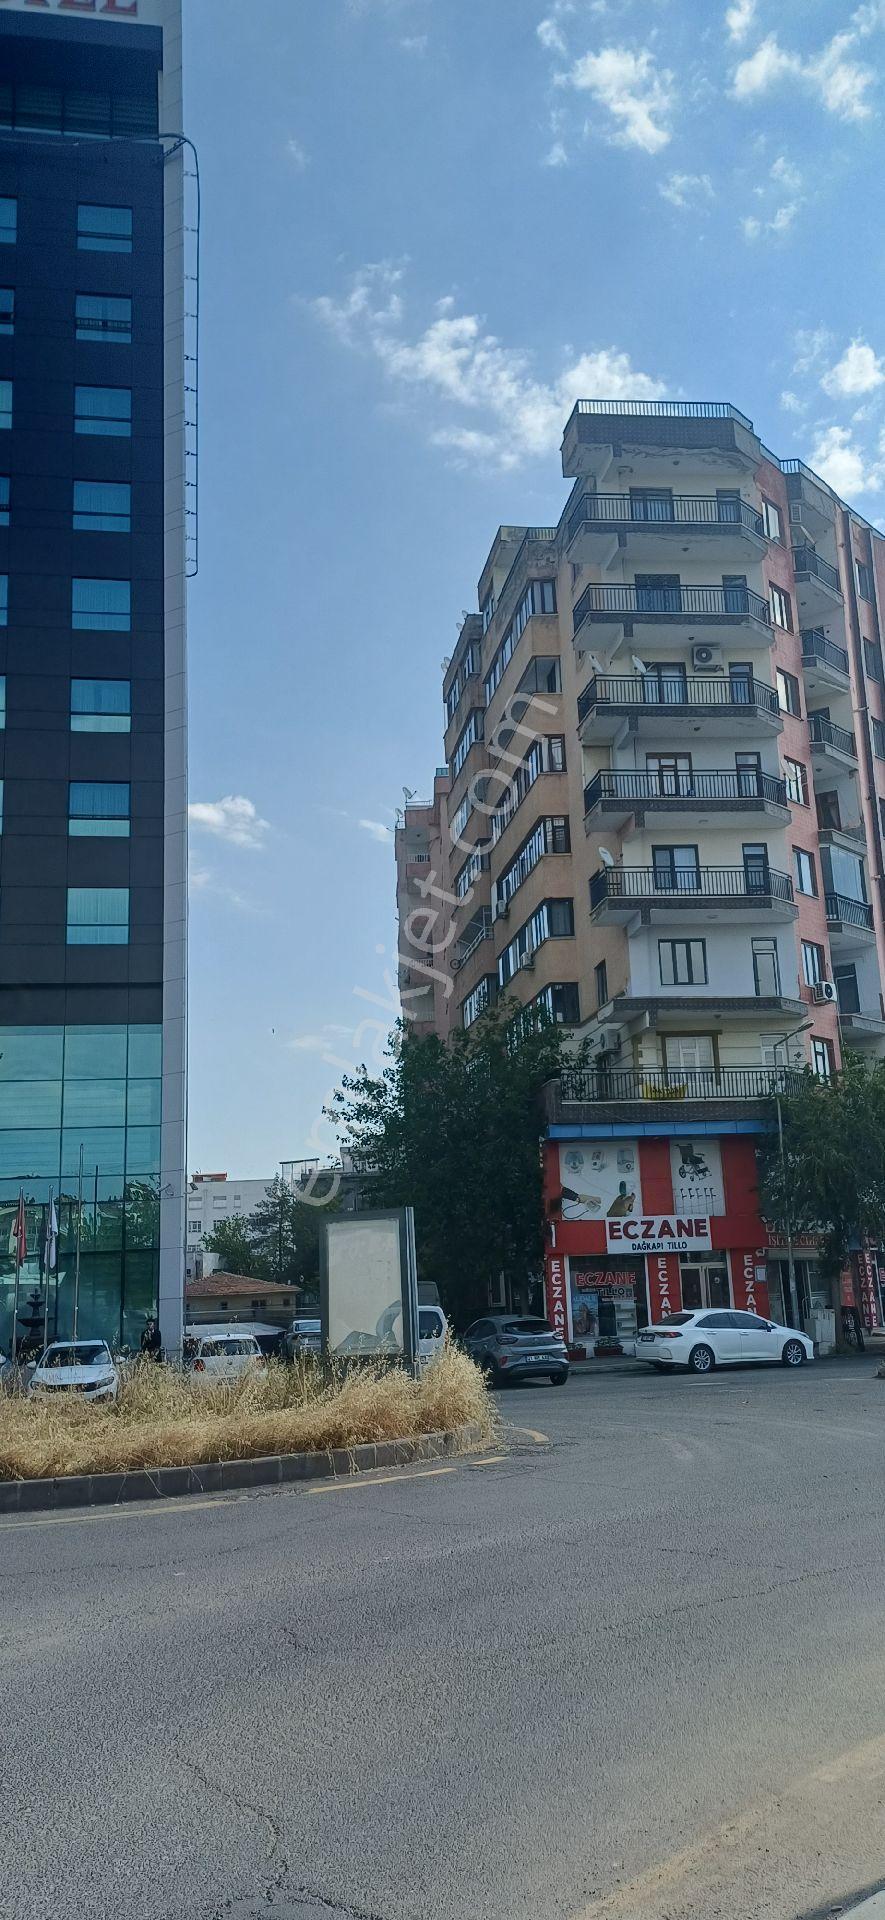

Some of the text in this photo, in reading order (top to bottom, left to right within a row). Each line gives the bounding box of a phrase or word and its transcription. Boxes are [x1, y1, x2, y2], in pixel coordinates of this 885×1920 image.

[609, 1219, 708, 1240] ECZANE
[631, 1241, 687, 1251] DAĞKAPI TILLO
[551, 1260, 565, 1340] ECZANE
[575, 1271, 637, 1287] ECZANE
[857, 1254, 871, 1327] ECZANE
[864, 1253, 878, 1327] ECZANE
